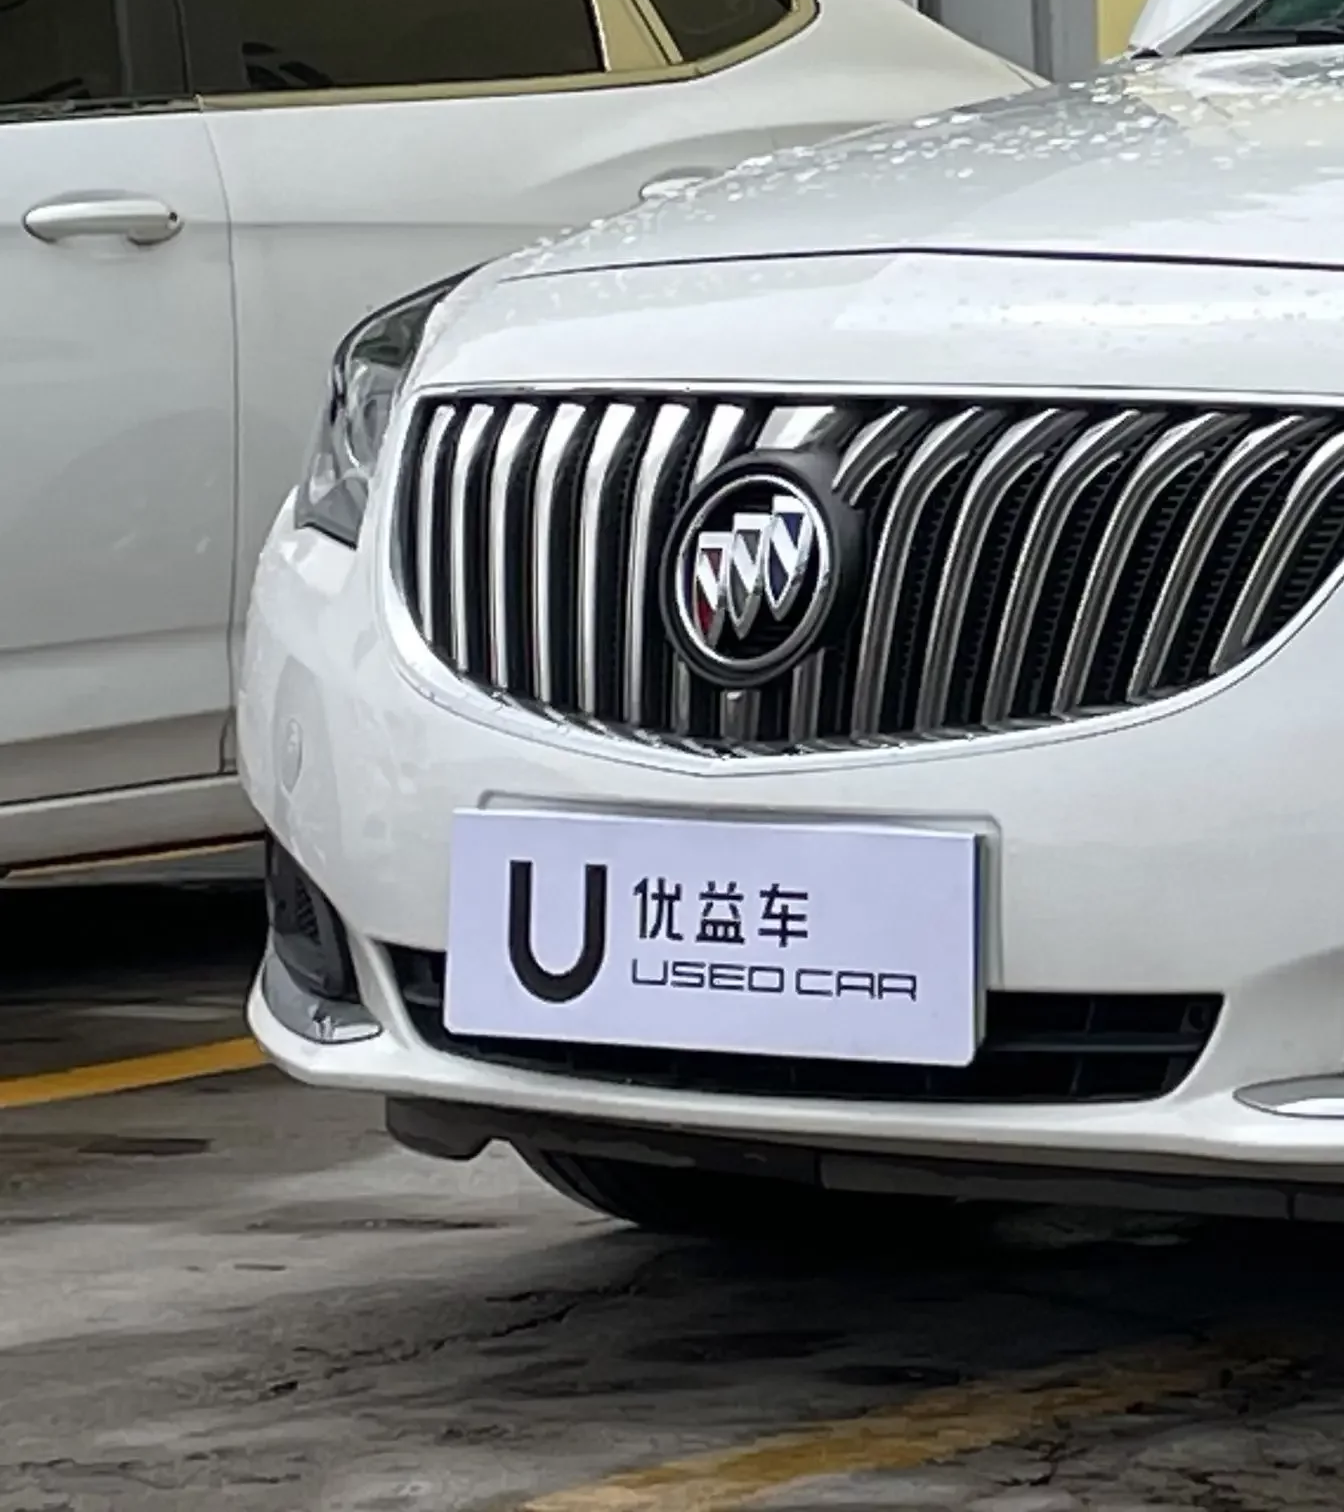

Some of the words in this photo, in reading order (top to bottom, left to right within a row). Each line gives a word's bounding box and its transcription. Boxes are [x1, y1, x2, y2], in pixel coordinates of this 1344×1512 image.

[508, 860, 607, 1004] U
[632, 876, 809, 948] 优益车
[631, 958, 784, 994] USED
[795, 969, 917, 1002] CAR
